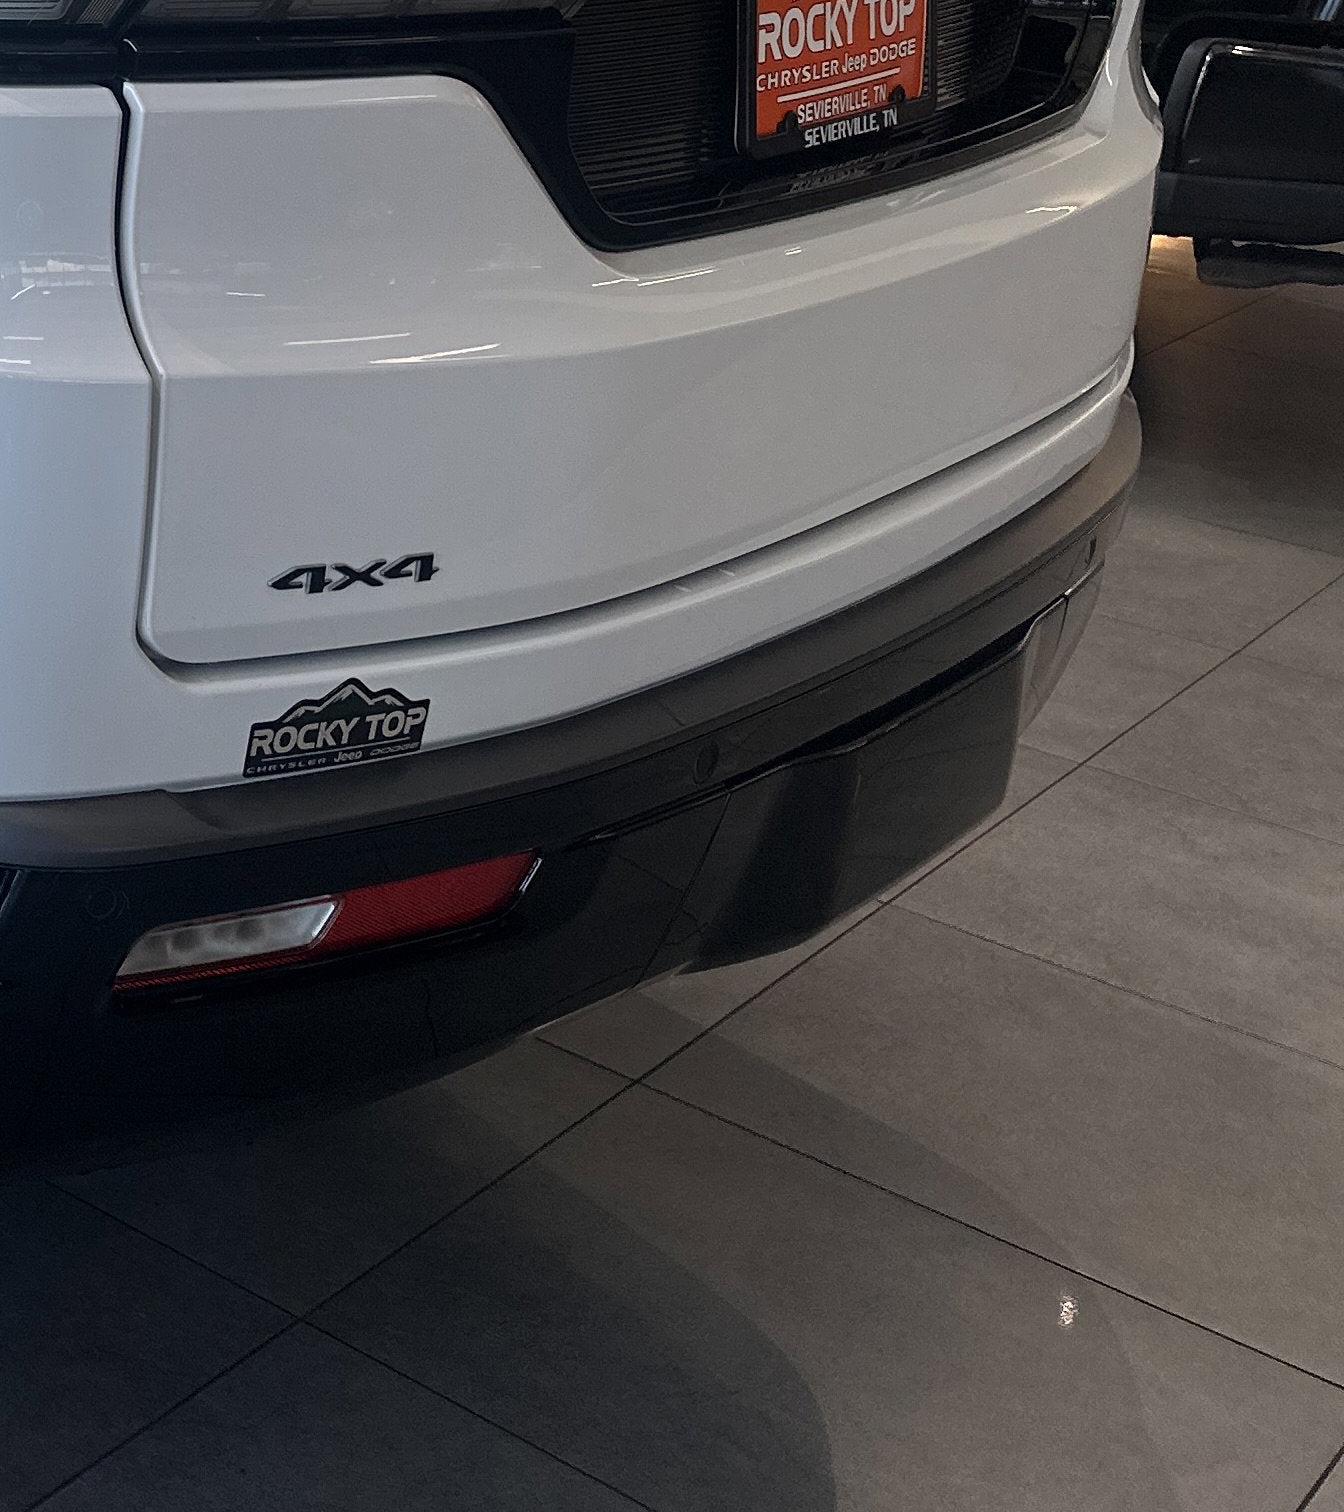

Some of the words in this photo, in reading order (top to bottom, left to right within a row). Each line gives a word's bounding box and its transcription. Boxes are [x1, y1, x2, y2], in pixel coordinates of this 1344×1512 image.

[756, 59, 839, 92] CHRYSLER
[841, 53, 867, 74] Jeep
[869, 37, 917, 66] DODGE
[797, 89, 871, 125] SEVIERVILLE,
[874, 84, 888, 104] TN
[804, 112, 880, 148] SEVIERVILLE,
[883, 108, 898, 127] TN
[249, 716, 360, 757] ROCKY
[365, 706, 427, 741] TOP
[246, 757, 327, 775] CHRYSLER
[333, 750, 363, 763] Jeep
[369, 741, 420, 756] DODGE
